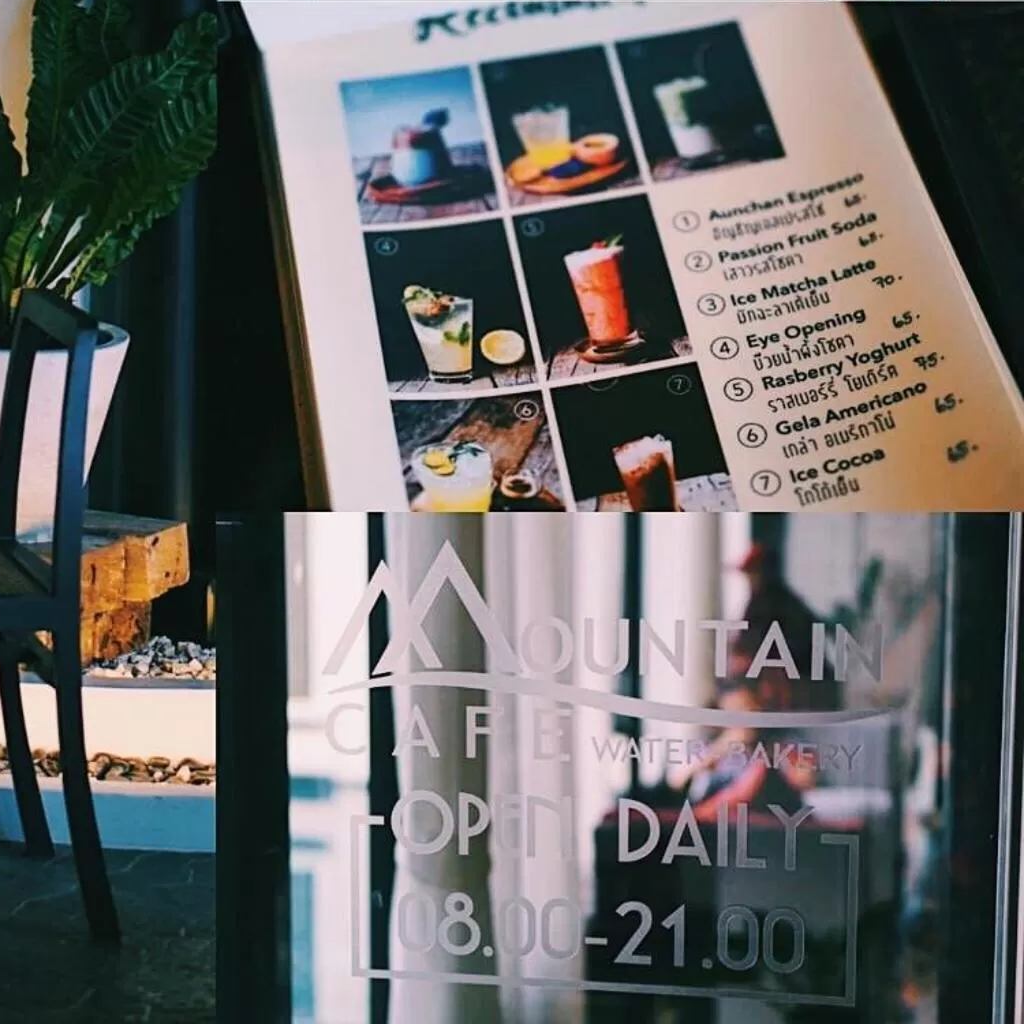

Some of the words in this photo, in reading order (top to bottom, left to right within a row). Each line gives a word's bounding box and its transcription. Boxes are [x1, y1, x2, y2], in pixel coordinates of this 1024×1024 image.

[708, 195, 784, 222] Aunchan
[787, 172, 864, 205] Espresso
[718, 237, 784, 263] Passion
[788, 226, 829, 252] Fruit
[831, 210, 877, 236] Soda
[730, 290, 757, 307] Ice
[761, 274, 828, 302] Matcha
[831, 258, 877, 283] Latte
[745, 330, 781, 353] Eye
[784, 308, 867, 337] Opening
[762, 361, 844, 390] Rasberry
[845, 333, 921, 367] Yoghurt
[775, 415, 821, 436] Gela
[825, 381, 928, 425] Americano
[790, 467, 818, 484] Ice
[823, 447, 886, 475] Cocoa
[326, 702, 571, 763] CAFE
[592, 735, 705, 766] WATER
[728, 740, 863, 772] BAKERY
[390, 790, 573, 861] OPEN
[618, 798, 816, 871] DAILY
[397, 891, 807, 974] 08.00-21.00
